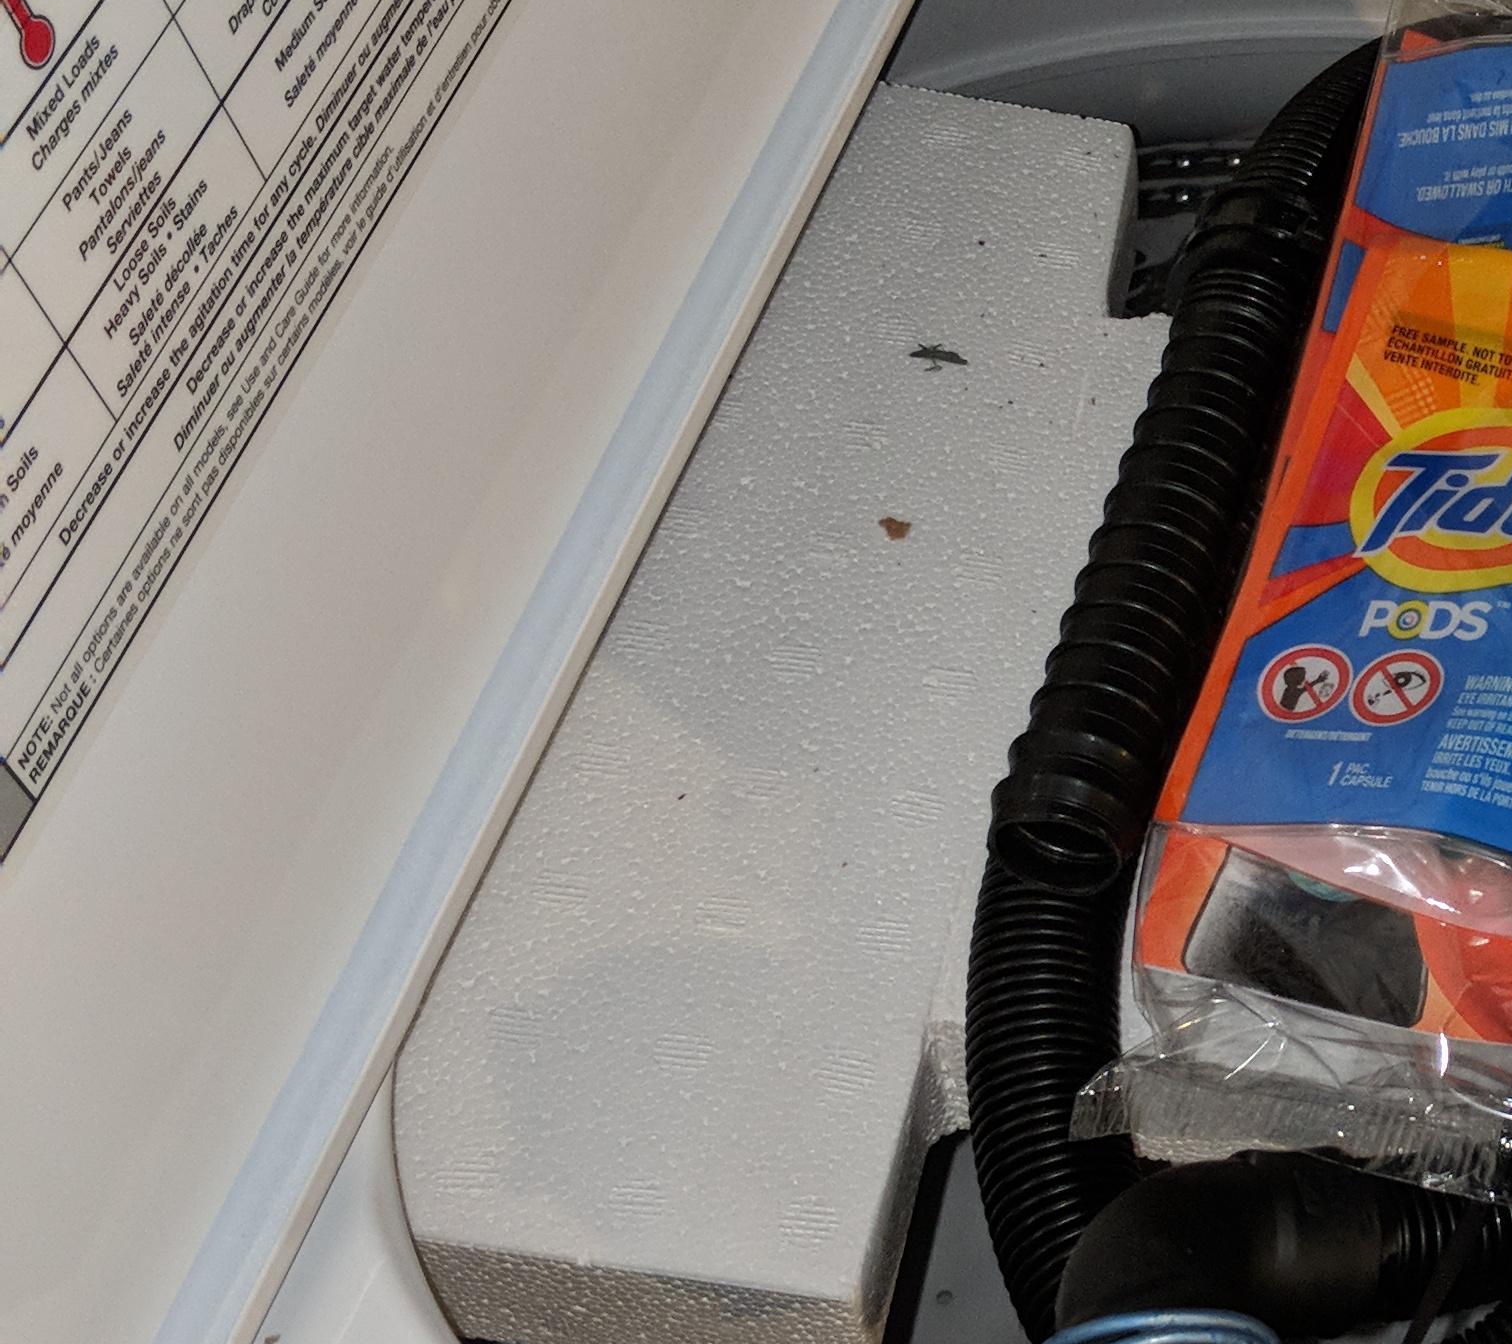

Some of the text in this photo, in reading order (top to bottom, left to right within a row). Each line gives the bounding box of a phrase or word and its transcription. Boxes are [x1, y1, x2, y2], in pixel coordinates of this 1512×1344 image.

[273, 10, 316, 72] Medium
[283, 55, 317, 108] Saleté
[25, 35, 100, 141] Mixed Loads
[31, 44, 119, 171] Charges mixtes
[61, 109, 133, 212] Pants/Jeans
[78, 129, 166, 262] Pantalons/jeans
[88, 146, 132, 206] Towels
[106, 170, 162, 255] Serviettes
[112, 196, 177, 292] Loose Soils
[103, 179, 208, 340] Heavy Soils Stains
[116, 205, 238, 398] Saleté intense Taches
[128, 223, 208, 346] Saleté décollée
[1383, 350, 1480, 386] VENTE INTERDITE.
[1392, 324, 1420, 341] FREE
[1472, 346, 1495, 361] NOT
[1499, 352, 1512, 367] TO
[1358, 599, 1493, 641] PODS
[1328, 760, 1370, 786] 1 PAC
[1339, 774, 1394, 789] CAPSULE
